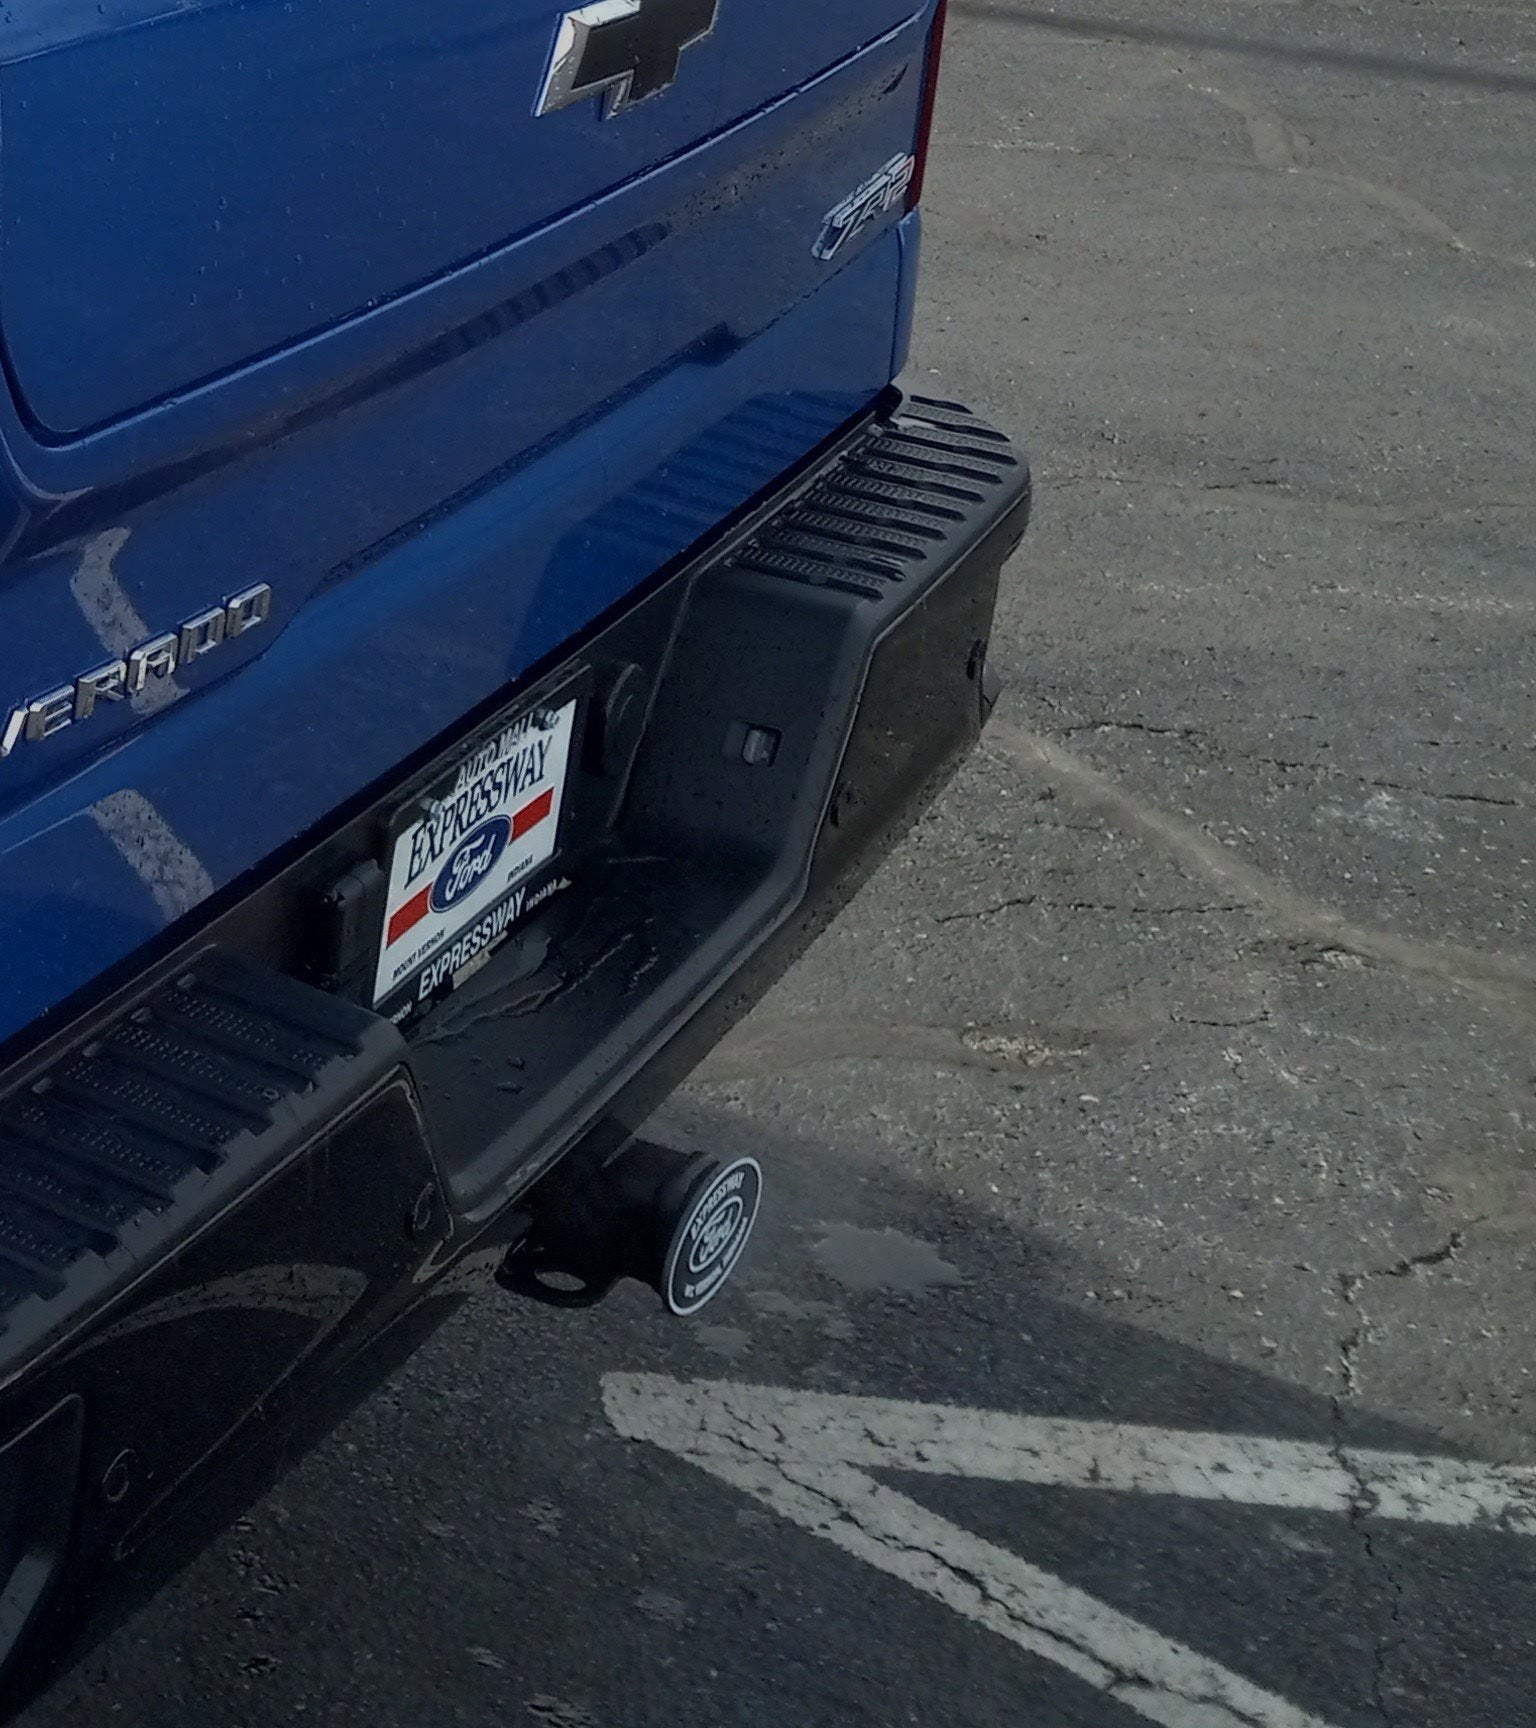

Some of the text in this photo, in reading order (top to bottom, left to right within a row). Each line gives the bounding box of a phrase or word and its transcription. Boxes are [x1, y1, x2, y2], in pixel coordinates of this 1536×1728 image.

[404, 734, 553, 890] EXPRESSWAY
[444, 832, 497, 902] Ford
[418, 886, 526, 1002] EXPRESSWAY
[690, 1171, 746, 1241] EXPRESSWAY
